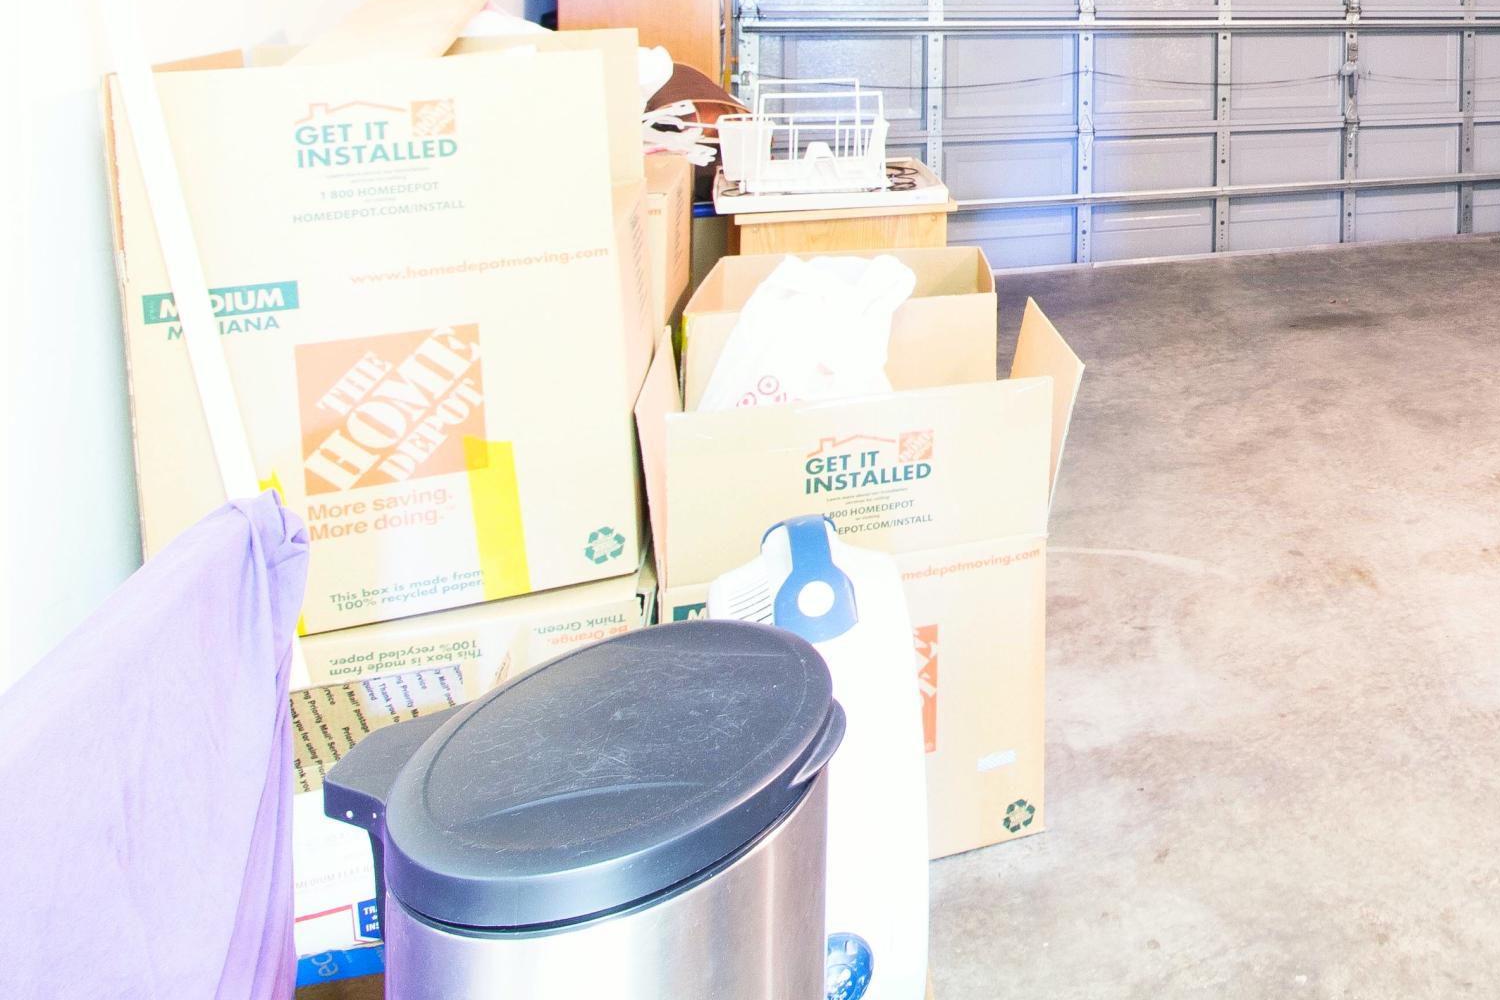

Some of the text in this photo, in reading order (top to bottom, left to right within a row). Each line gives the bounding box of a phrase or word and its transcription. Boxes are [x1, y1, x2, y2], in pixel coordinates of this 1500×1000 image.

[295, 120, 389, 146] GET IT
[297, 139, 458, 168] INSTALLED
[331, 188, 353, 200] 800
[358, 181, 440, 198] HOMEDEPOT
[292, 200, 466, 224] HOMEDEPOT.COM/INSTALL
[350, 247, 609, 285] www.homedepotmoving.com
[160, 287, 285, 319] MDIUM
[167, 315, 281, 341] MIANA
[316, 351, 393, 416] THE
[303, 327, 482, 490] HOME
[378, 378, 485, 480] DEPOT
[805, 450, 880, 475] GET IT
[805, 462, 932, 494] INSTALLED
[307, 487, 454, 521] More saving.
[850, 499, 914, 516] HOMEDEPOT
[309, 509, 445, 541] More doing.
[838, 514, 934, 535] EPOT.COM/INSTALL
[901, 548, 1041, 581] medepotmoving.com
[329, 569, 485, 603] This box is made from
[336, 578, 486, 612] 100% recycled paper.
[533, 613, 626, 634] Think Green.
[547, 630, 605, 645] Orange.
[329, 640, 476, 666] 100% recycled paper.
[329, 648, 483, 676] This box is made from
